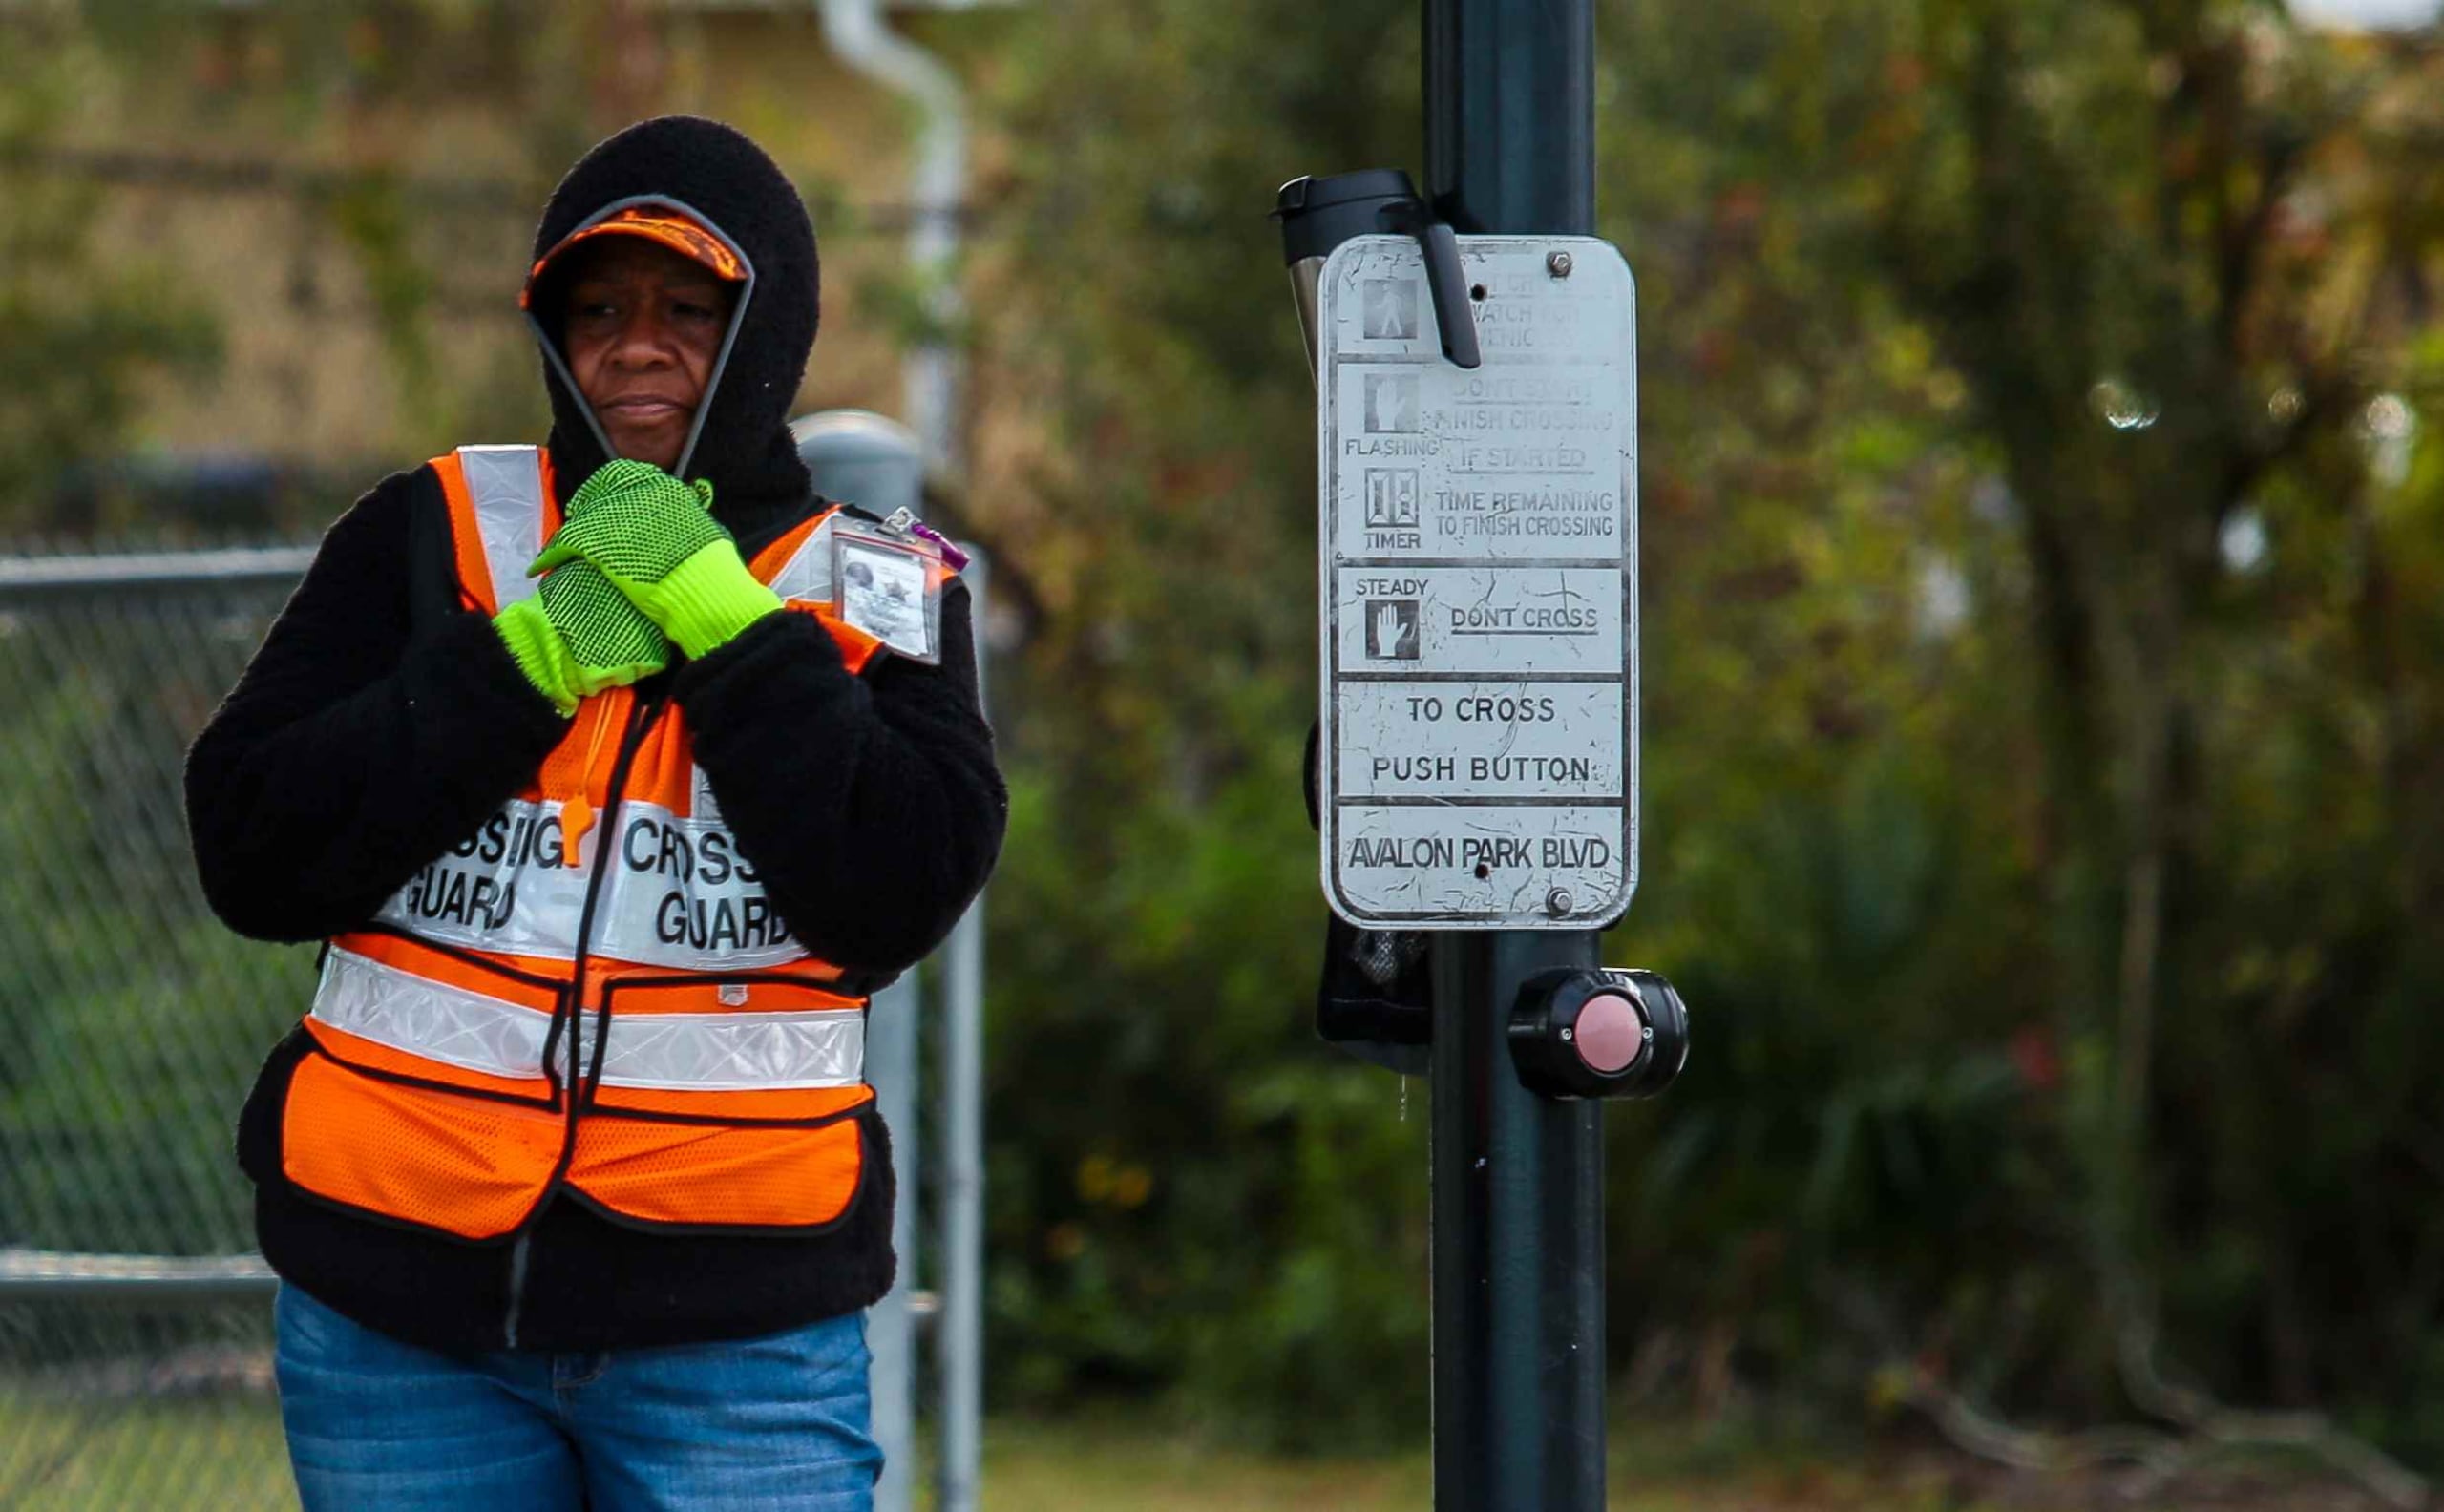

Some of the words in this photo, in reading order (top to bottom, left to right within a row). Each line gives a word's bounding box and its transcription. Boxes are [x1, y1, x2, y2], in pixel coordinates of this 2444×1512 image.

[1345, 439, 1438, 456] FLASHING
[1435, 492, 1486, 512] TIME
[1492, 491, 1613, 513] REMAINING
[1438, 516, 1458, 536] TO
[1463, 515, 1521, 536] FINISH
[1526, 515, 1613, 536] CROSSING
[1366, 532, 1421, 550] TIMER
[1356, 578, 1429, 596] STEADY
[1523, 607, 1598, 629] CROSS
[1407, 697, 1443, 722] TO
[1456, 697, 1555, 723] CROSS
[1373, 757, 1455, 782] PUSH
[1470, 757, 1589, 782] BUTTON
[1348, 837, 1454, 869] AVALON
[1462, 837, 1533, 869] PARK
[1541, 837, 1611, 869] BLVD
